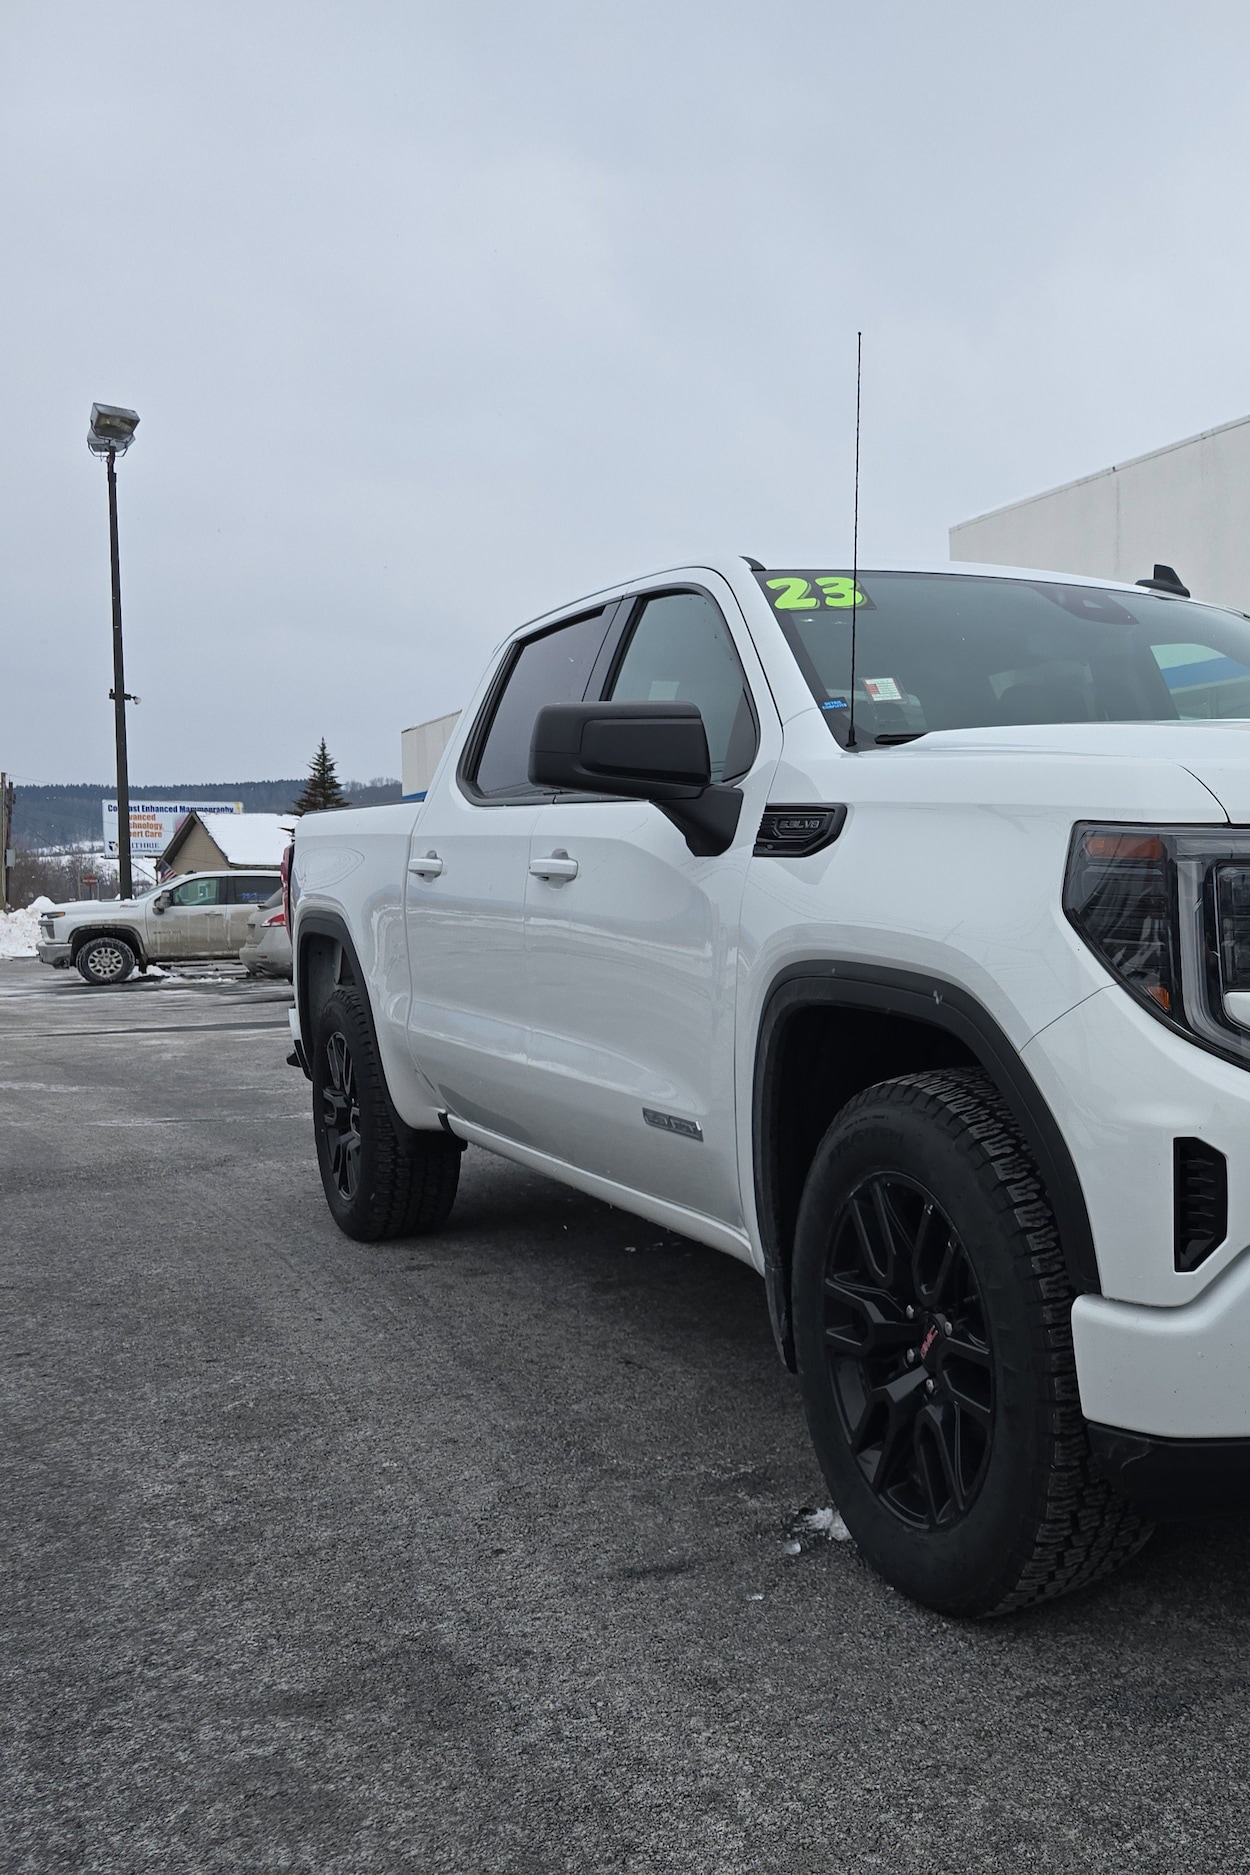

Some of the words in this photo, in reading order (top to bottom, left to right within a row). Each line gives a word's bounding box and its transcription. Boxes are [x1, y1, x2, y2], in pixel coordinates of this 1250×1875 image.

[766, 577, 867, 610] 23
[108, 804, 140, 813] Coast
[141, 804, 178, 813] Enhanced
[129, 813, 156, 821] vanced
[144, 830, 162, 838] Care
